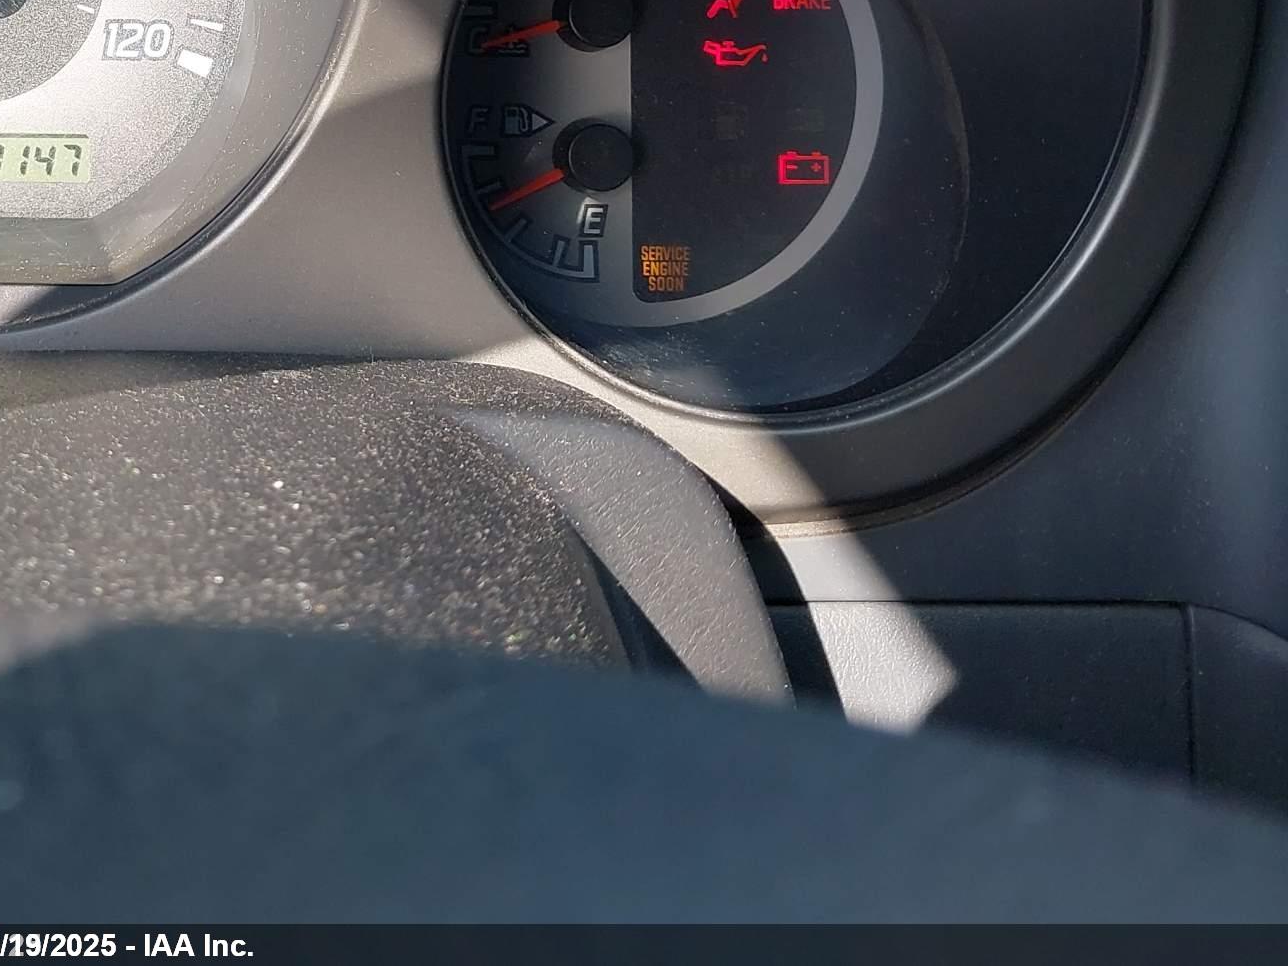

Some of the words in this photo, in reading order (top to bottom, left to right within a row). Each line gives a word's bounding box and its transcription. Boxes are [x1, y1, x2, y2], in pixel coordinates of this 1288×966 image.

[105, 21, 171, 58] 120
[468, 107, 489, 133] F
[584, 207, 605, 234] E
[640, 245, 691, 262] SERVICE
[642, 261, 689, 276] ENGINE
[648, 276, 685, 292] SOON
